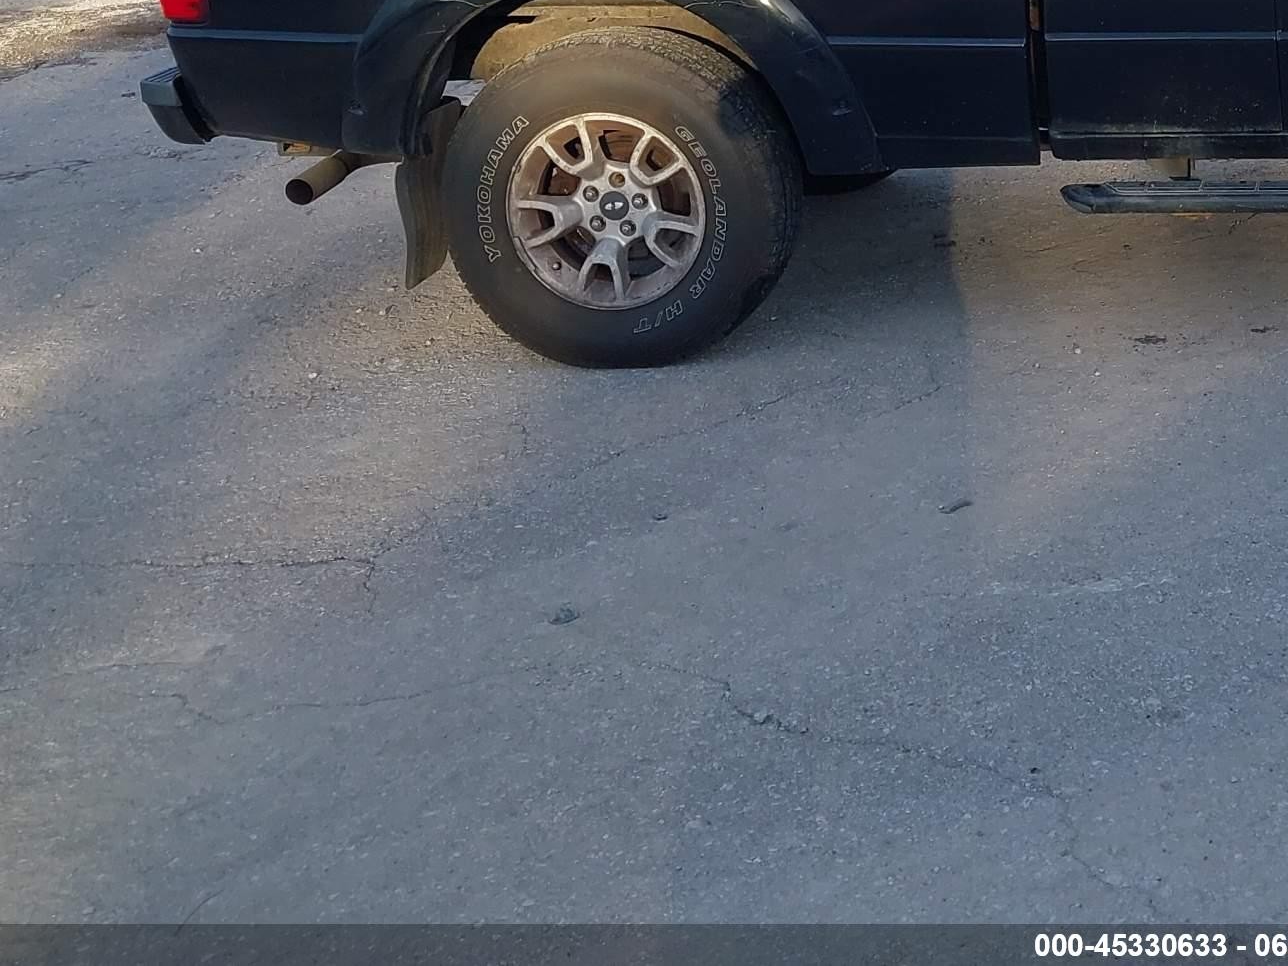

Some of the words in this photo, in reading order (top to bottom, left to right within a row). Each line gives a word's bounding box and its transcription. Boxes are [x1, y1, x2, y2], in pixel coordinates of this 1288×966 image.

[477, 115, 530, 263] YOKOHAMA
[674, 125, 727, 299] GEOLANDAR
[633, 299, 684, 333] H/T
